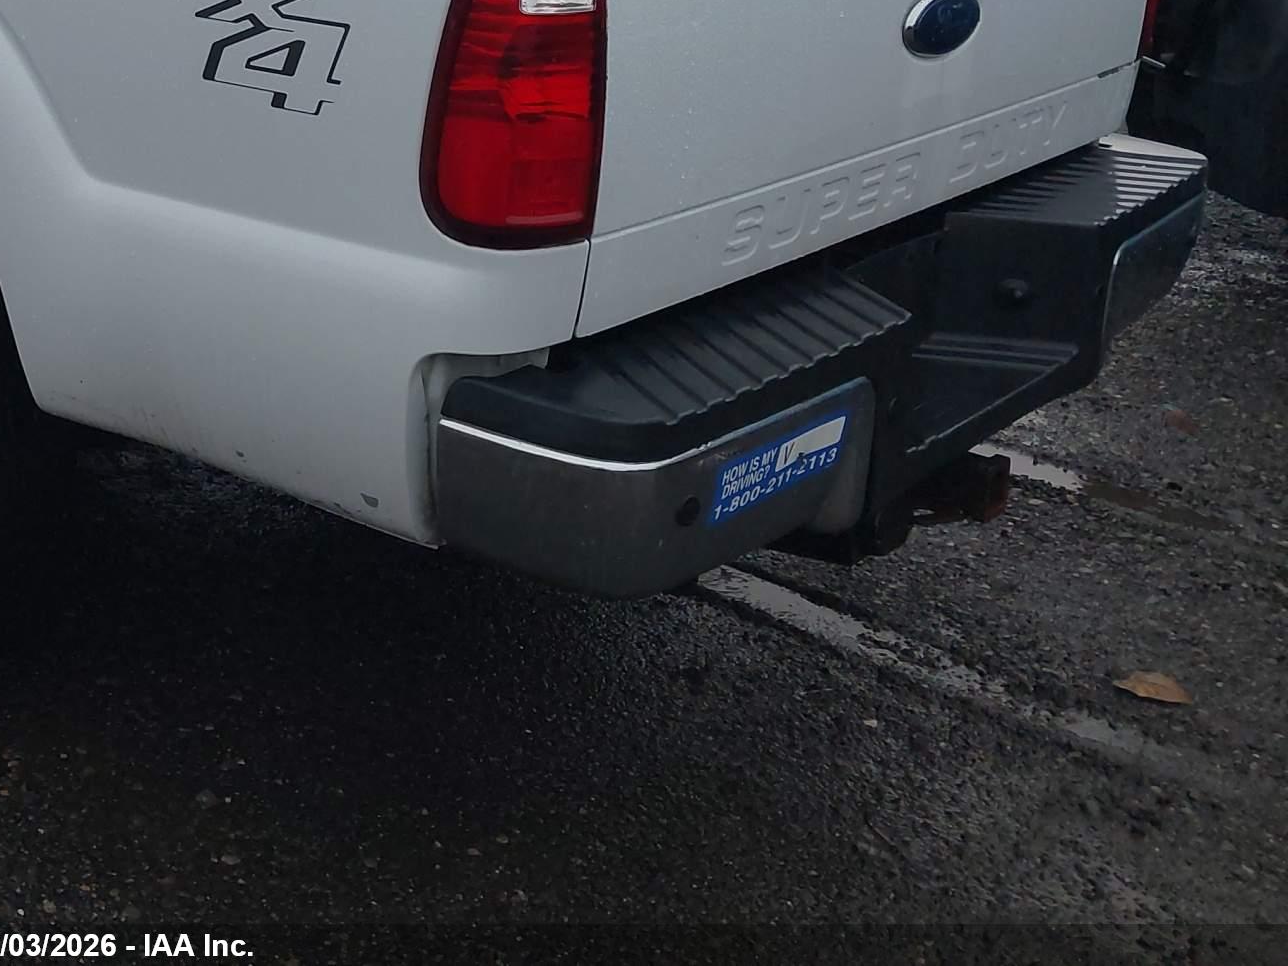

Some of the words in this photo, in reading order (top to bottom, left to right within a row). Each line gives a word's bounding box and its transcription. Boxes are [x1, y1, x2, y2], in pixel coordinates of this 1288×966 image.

[721, 150, 922, 267] SUPER
[714, 447, 838, 521] 1-800-211-2113
[720, 464, 771, 500] DRIVING?
[721, 460, 749, 486] HOW
[749, 456, 761, 473] IS
[761, 447, 779, 467] MY
